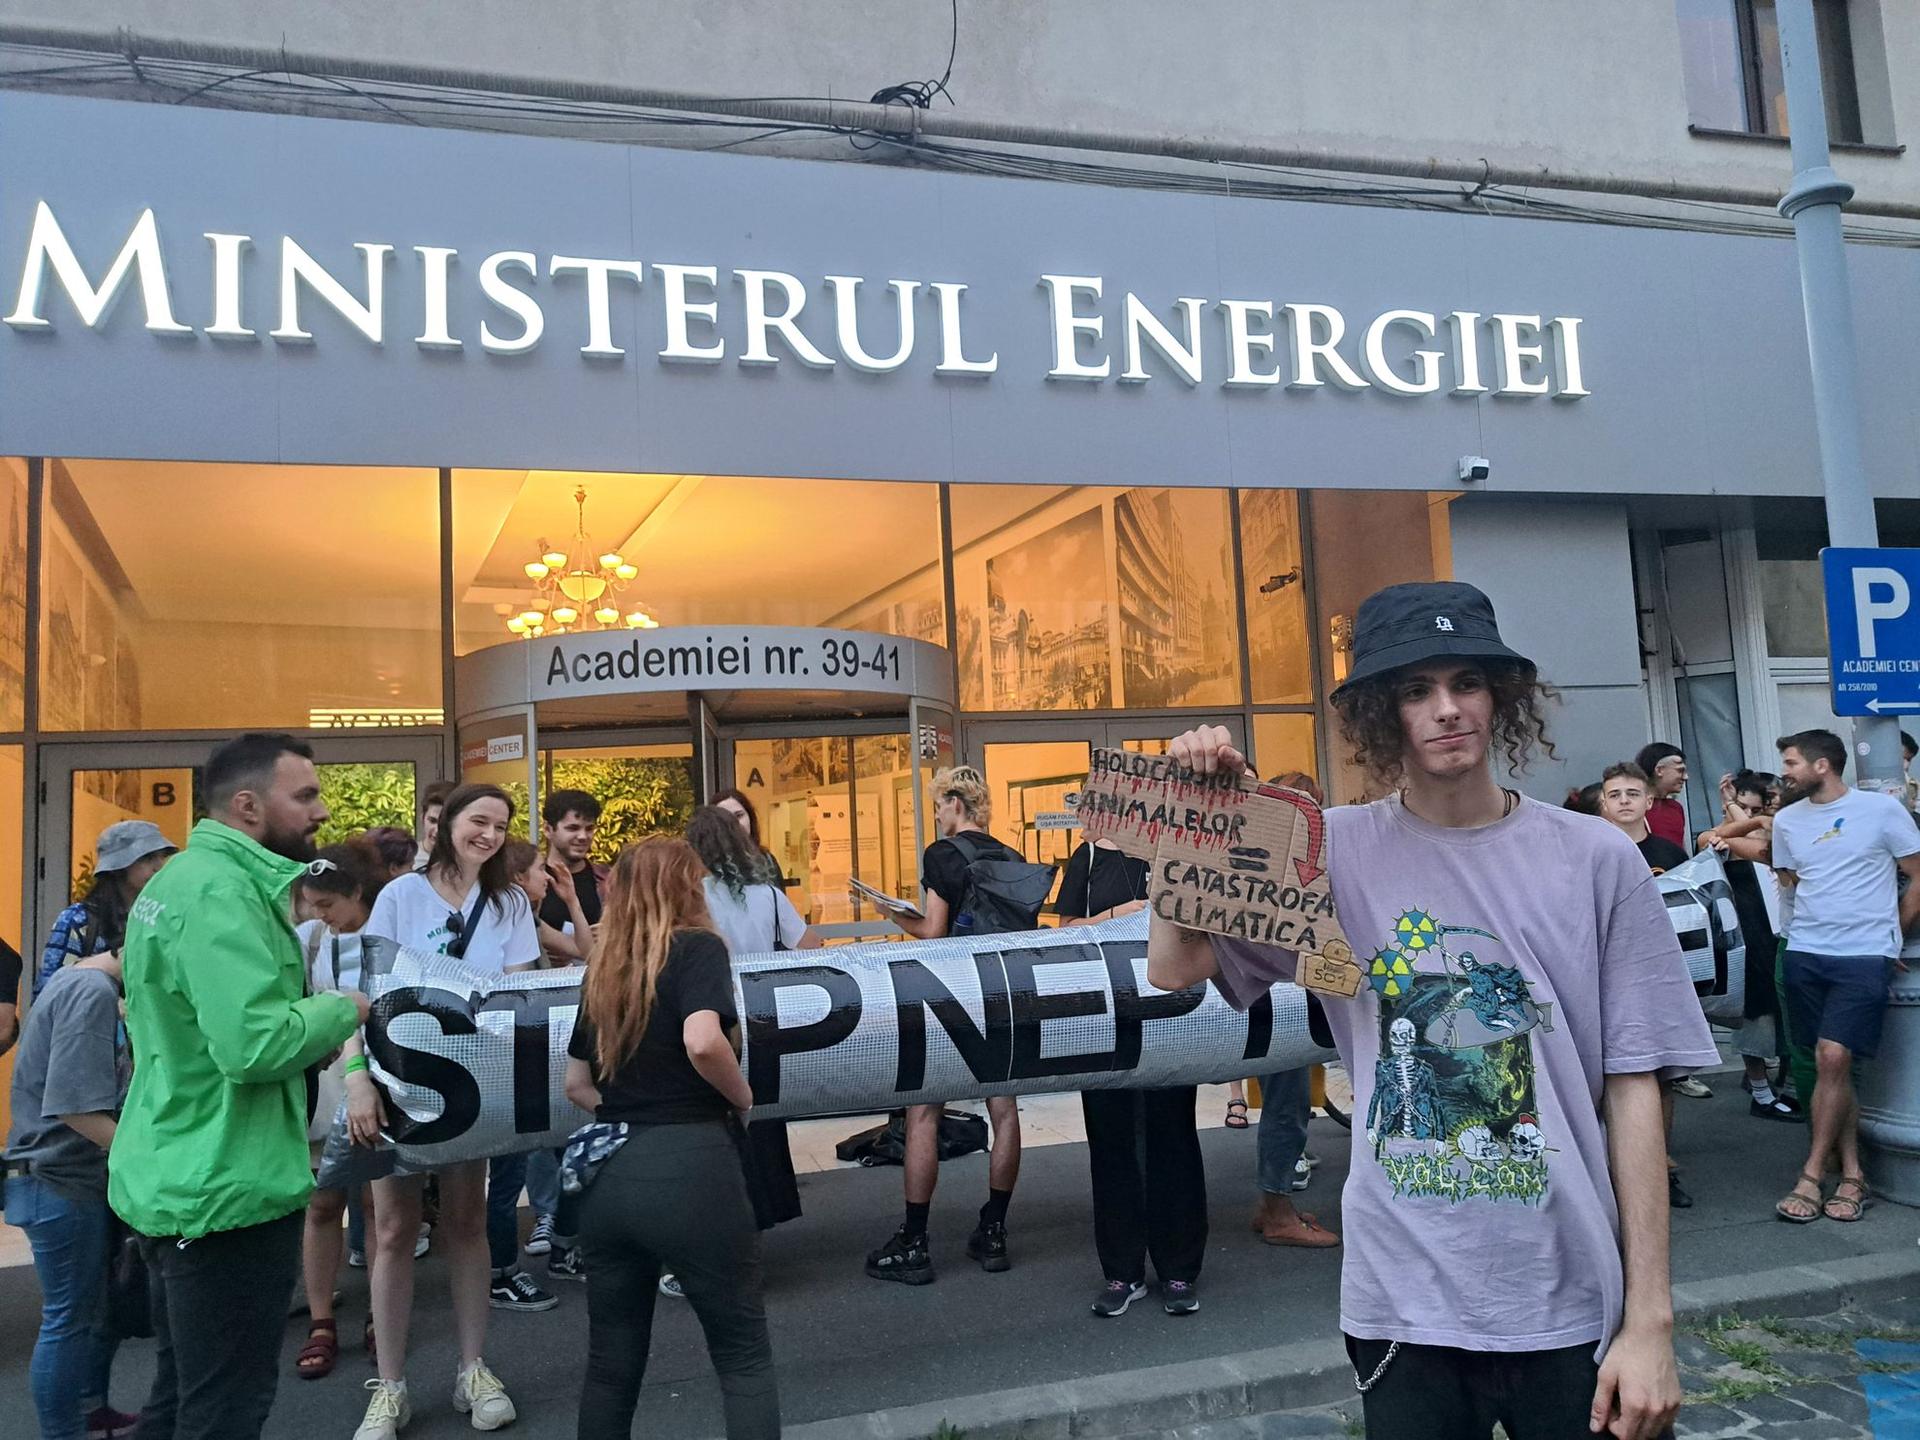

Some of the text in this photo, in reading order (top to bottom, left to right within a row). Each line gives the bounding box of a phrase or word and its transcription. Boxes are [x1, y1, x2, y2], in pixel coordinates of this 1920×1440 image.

[3, 200, 1592, 400] MINISTERUL ENERGIEI
[1852, 567, 1911, 658] P
[547, 635, 901, 686] Academiei nr. 39-41
[1842, 660, 1920, 673] ACADEMIEI CEN
[488, 742, 520, 755] CENTER
[152, 782, 176, 807] B
[746, 768, 764, 787] A
[1078, 789, 1248, 844] ANIMALELOR
[1163, 859, 1335, 918] CATASTROFA
[366, 964, 863, 1146] STP
[1381, 1150, 1550, 1208] VOLCOM
